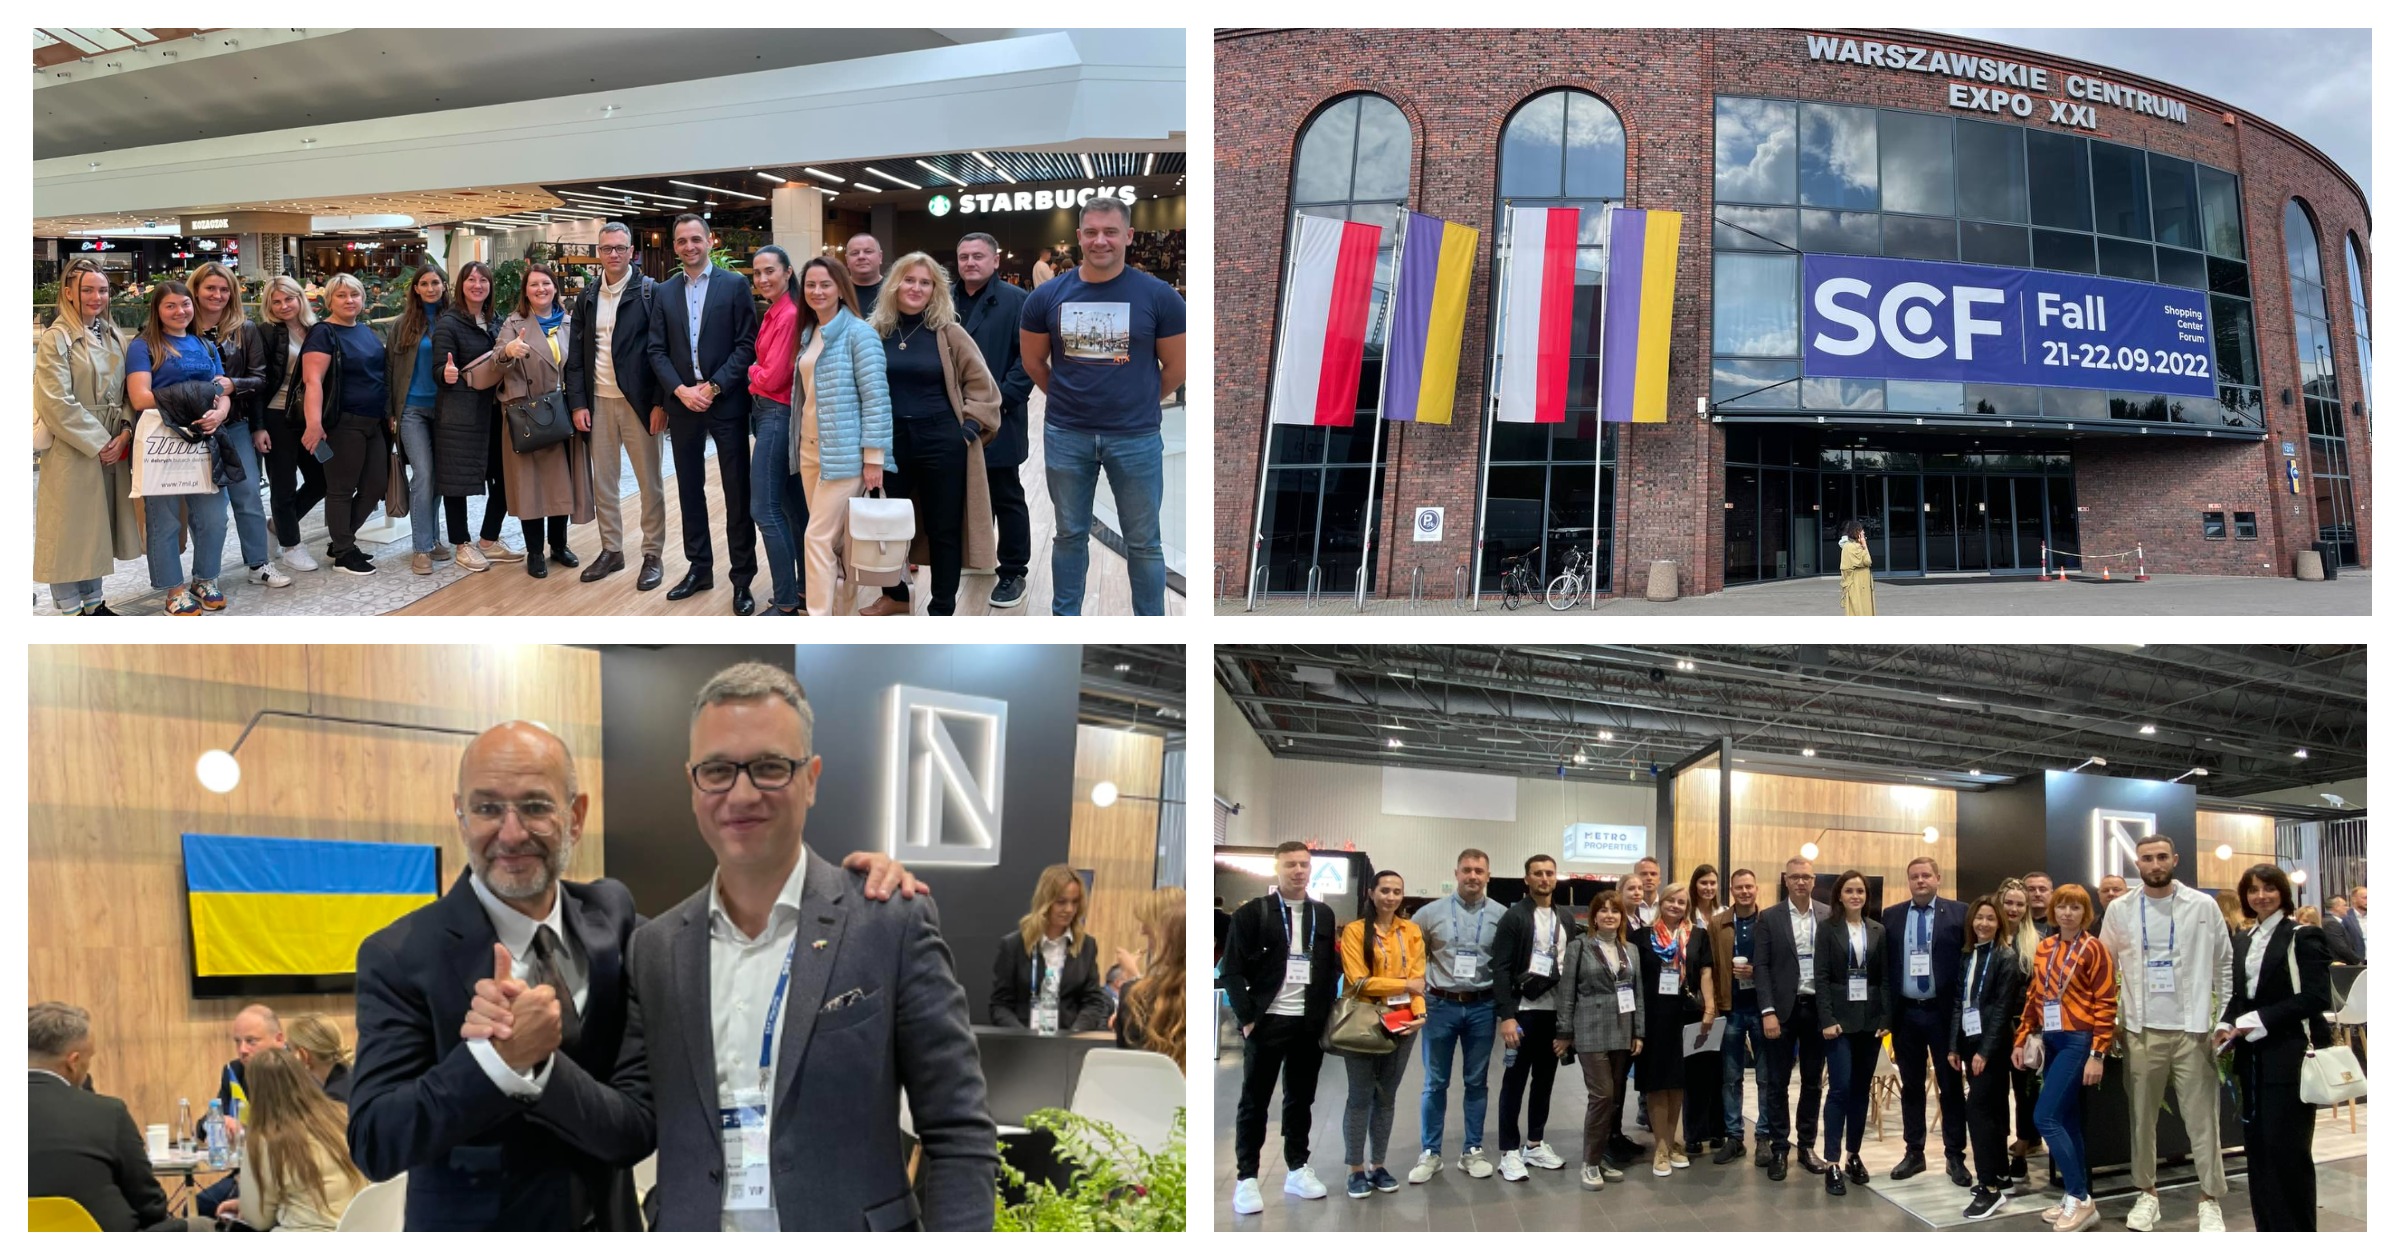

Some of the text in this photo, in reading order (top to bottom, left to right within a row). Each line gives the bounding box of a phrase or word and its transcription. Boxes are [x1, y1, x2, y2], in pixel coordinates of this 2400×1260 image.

[1806, 35, 2188, 125] WARSZAWSKIE CENTRUM
[1949, 83, 2097, 130] EXPO XXI
[959, 185, 1138, 214] STARBUCKS
[1813, 277, 2005, 361] SCF
[2037, 292, 2106, 332] Fall
[2164, 305, 2203, 321] Shopping
[2177, 319, 2204, 331] Center
[2178, 331, 2205, 344] Forum
[2041, 341, 2210, 378] 21-22.09.2022
[1584, 831, 1627, 841] METRO
[1584, 842, 1638, 851] PROPERTIES
